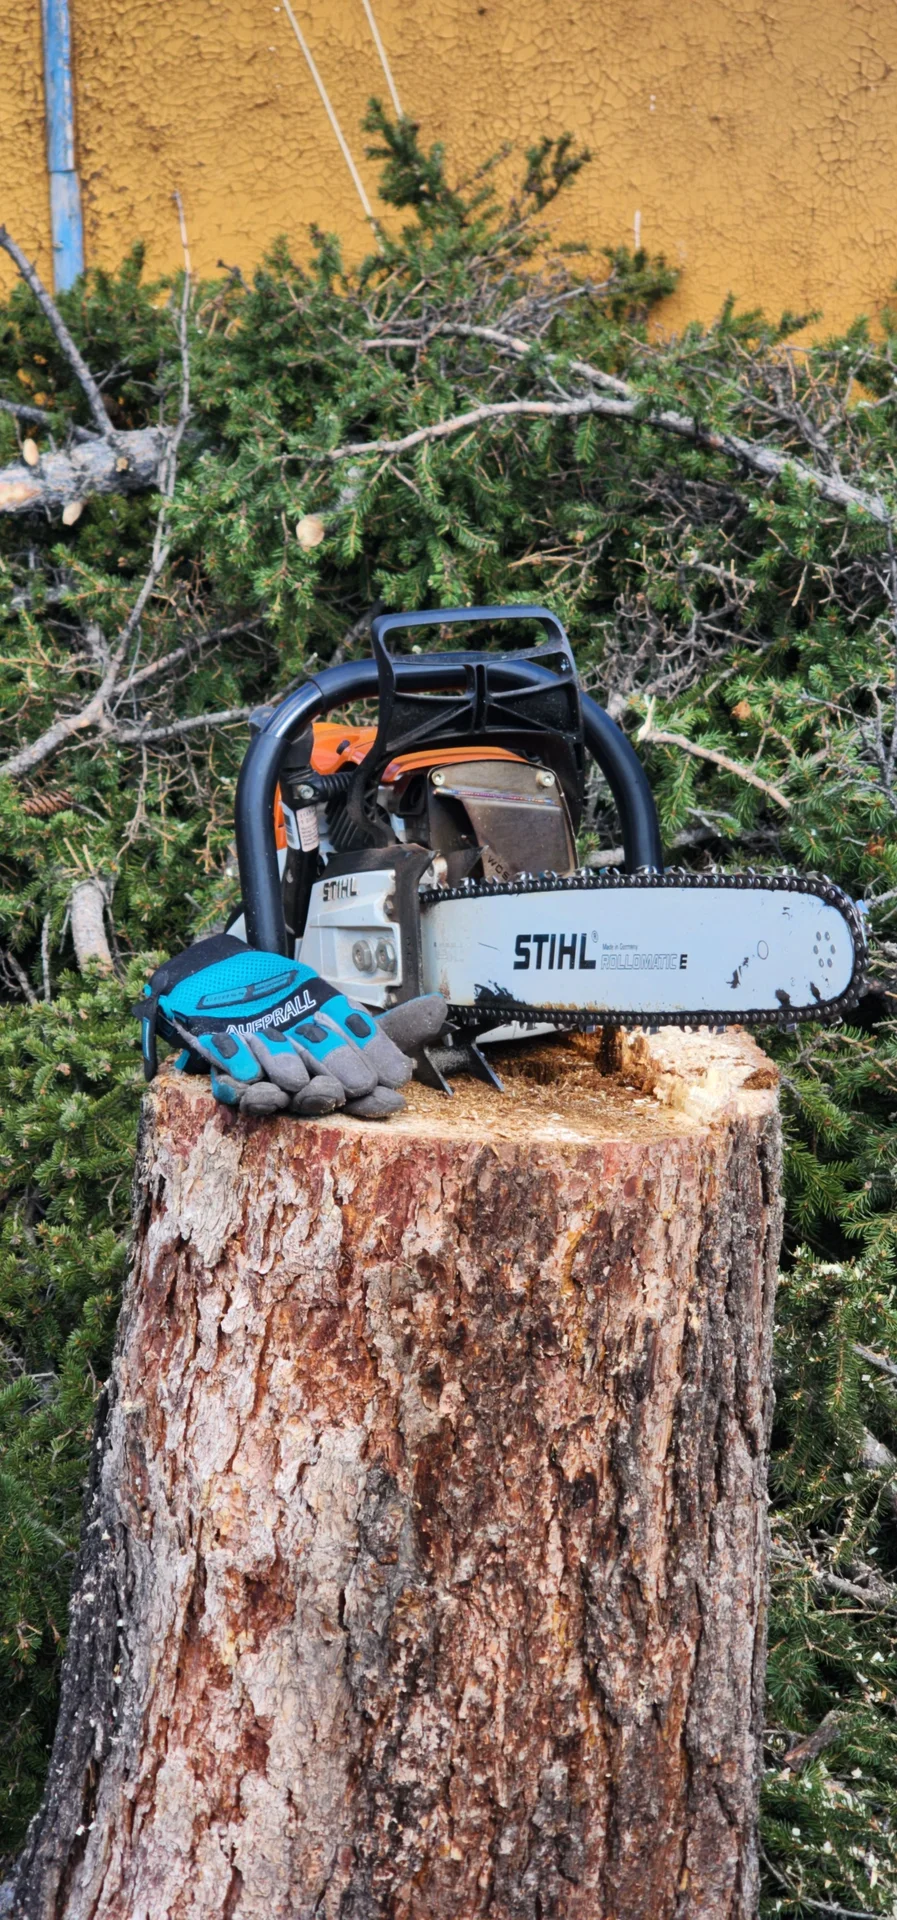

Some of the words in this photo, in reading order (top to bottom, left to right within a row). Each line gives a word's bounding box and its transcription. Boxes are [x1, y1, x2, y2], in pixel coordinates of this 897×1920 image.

[323, 877, 358, 902] STIHL
[513, 933, 597, 970] STIHL
[600, 953, 677, 970] ROLLOMATIC
[679, 954, 688, 970] E
[225, 989, 317, 1035] AUFPRALL
